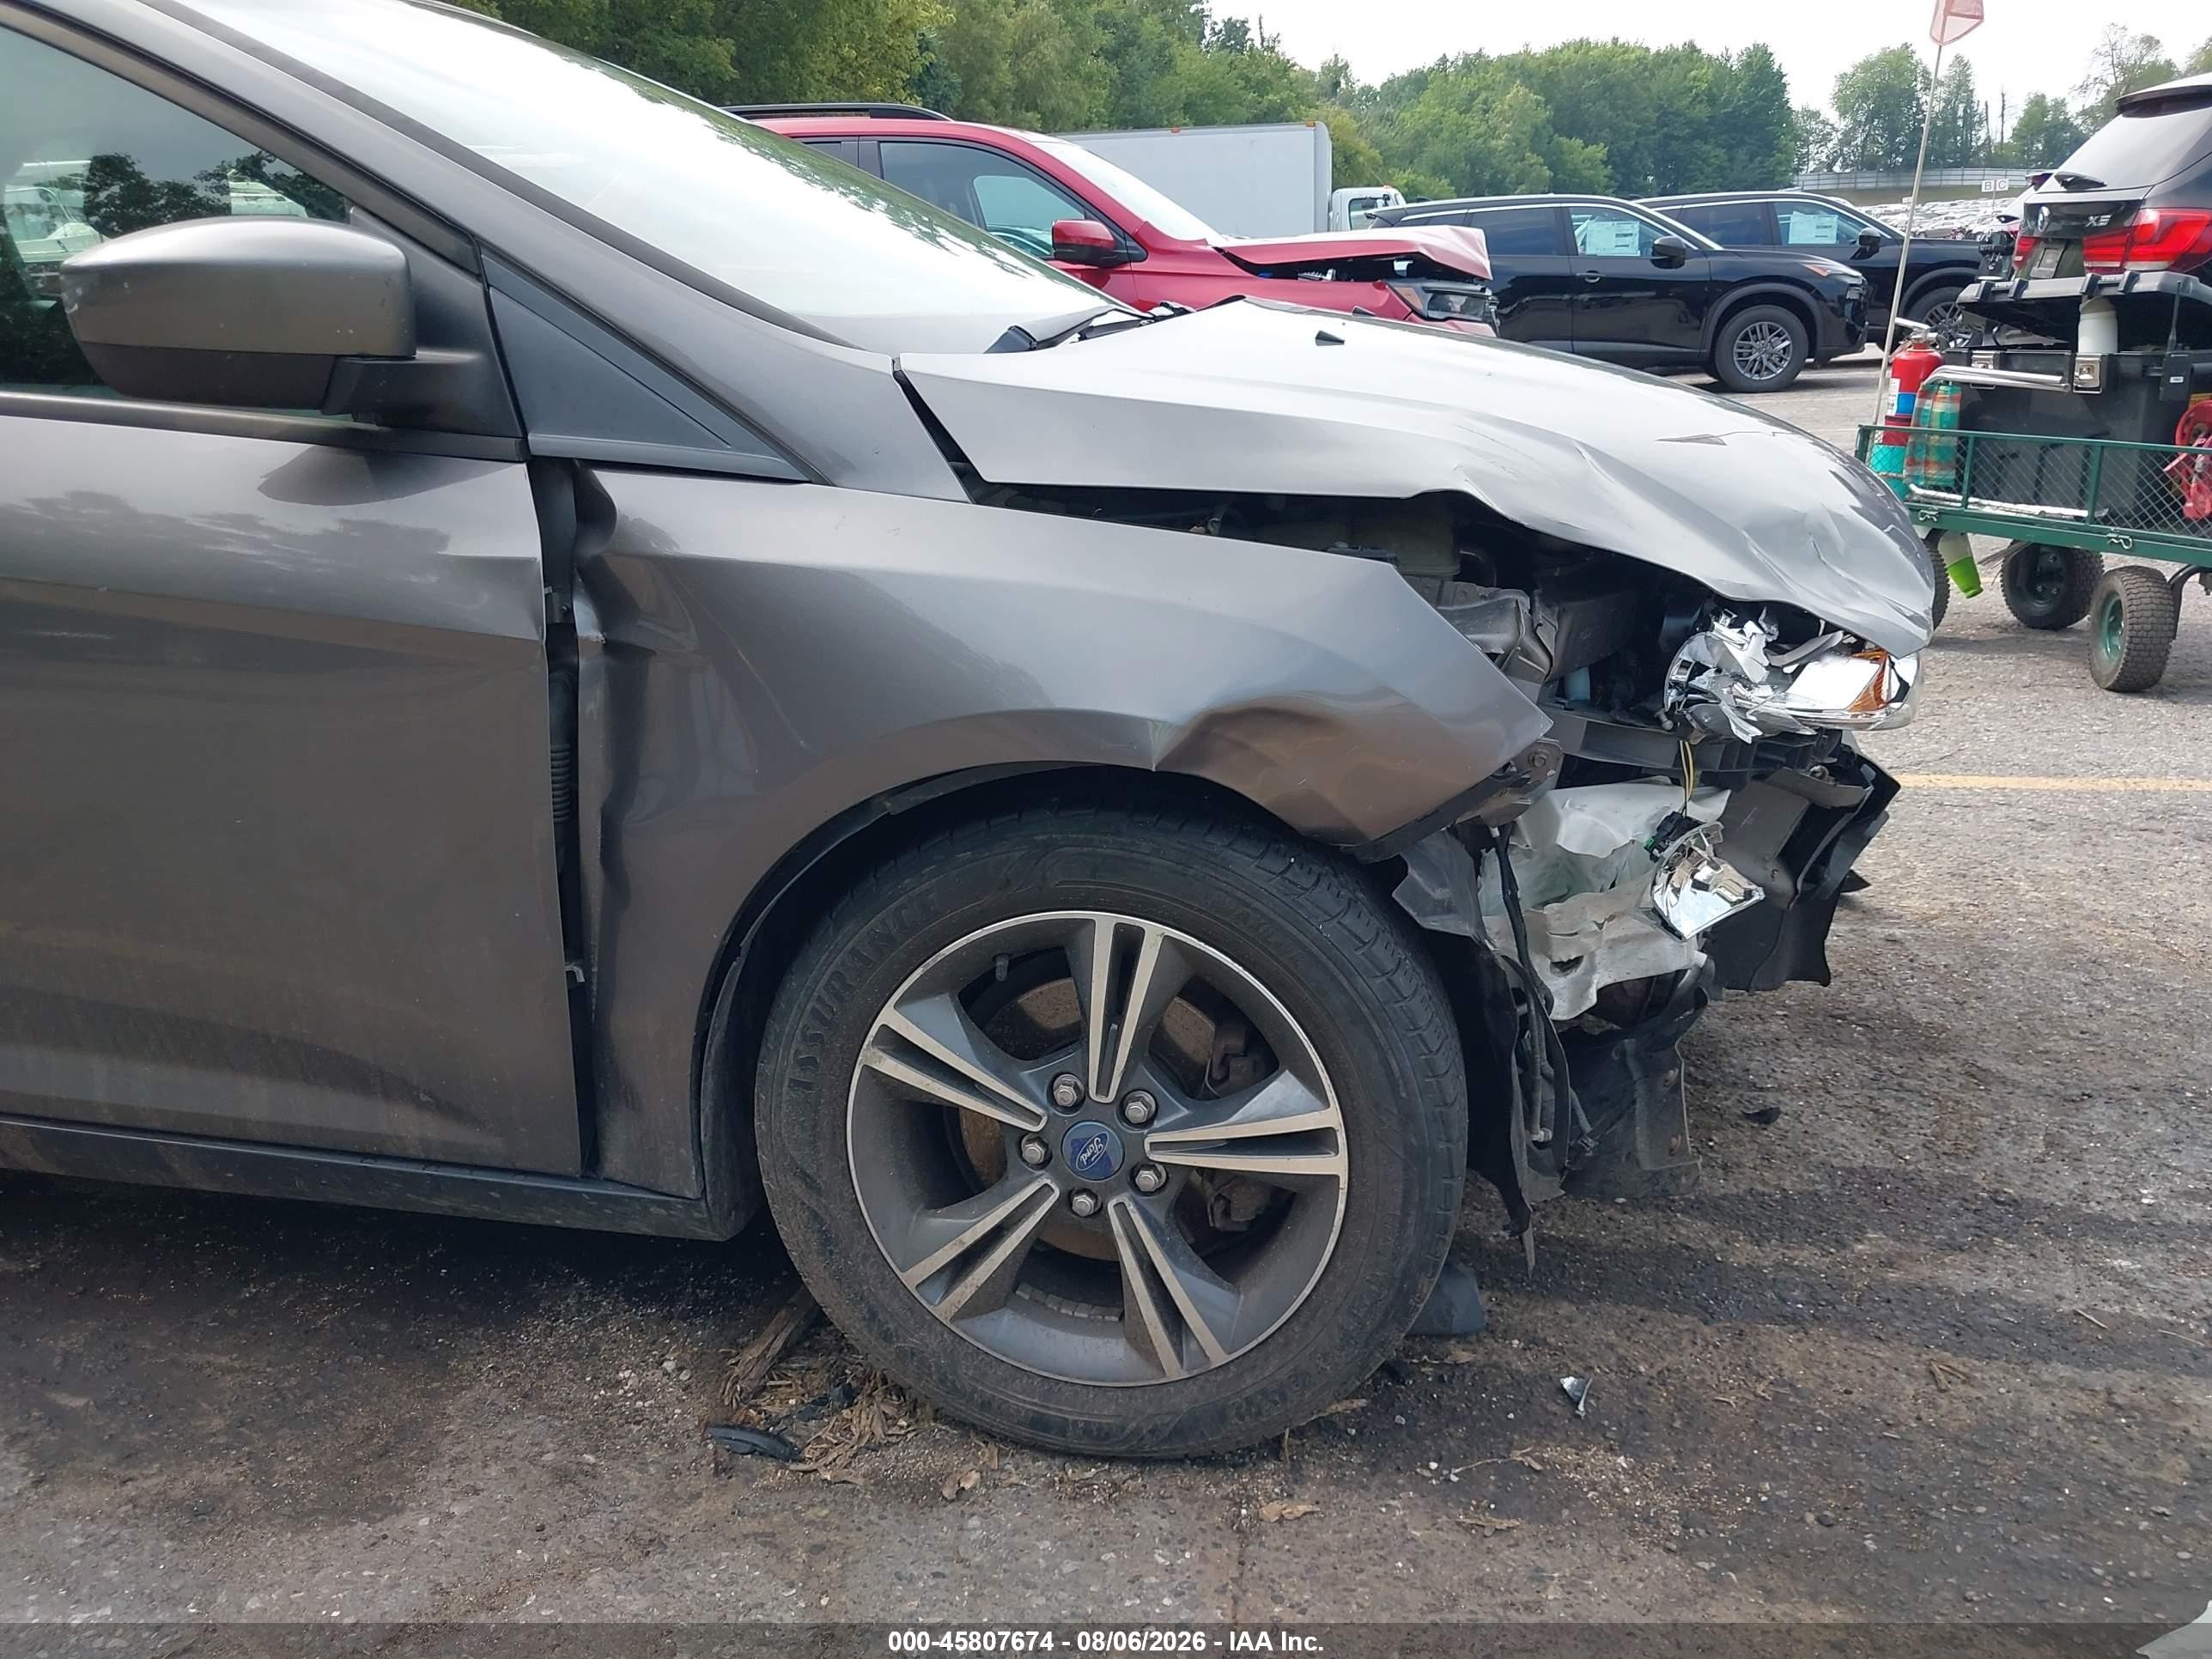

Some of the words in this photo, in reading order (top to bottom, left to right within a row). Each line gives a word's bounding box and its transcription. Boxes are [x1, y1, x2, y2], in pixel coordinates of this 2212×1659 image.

[1984, 181, 1992, 190] B
[1998, 179, 2007, 189] C
[1079, 1137, 1104, 1165] Ford
